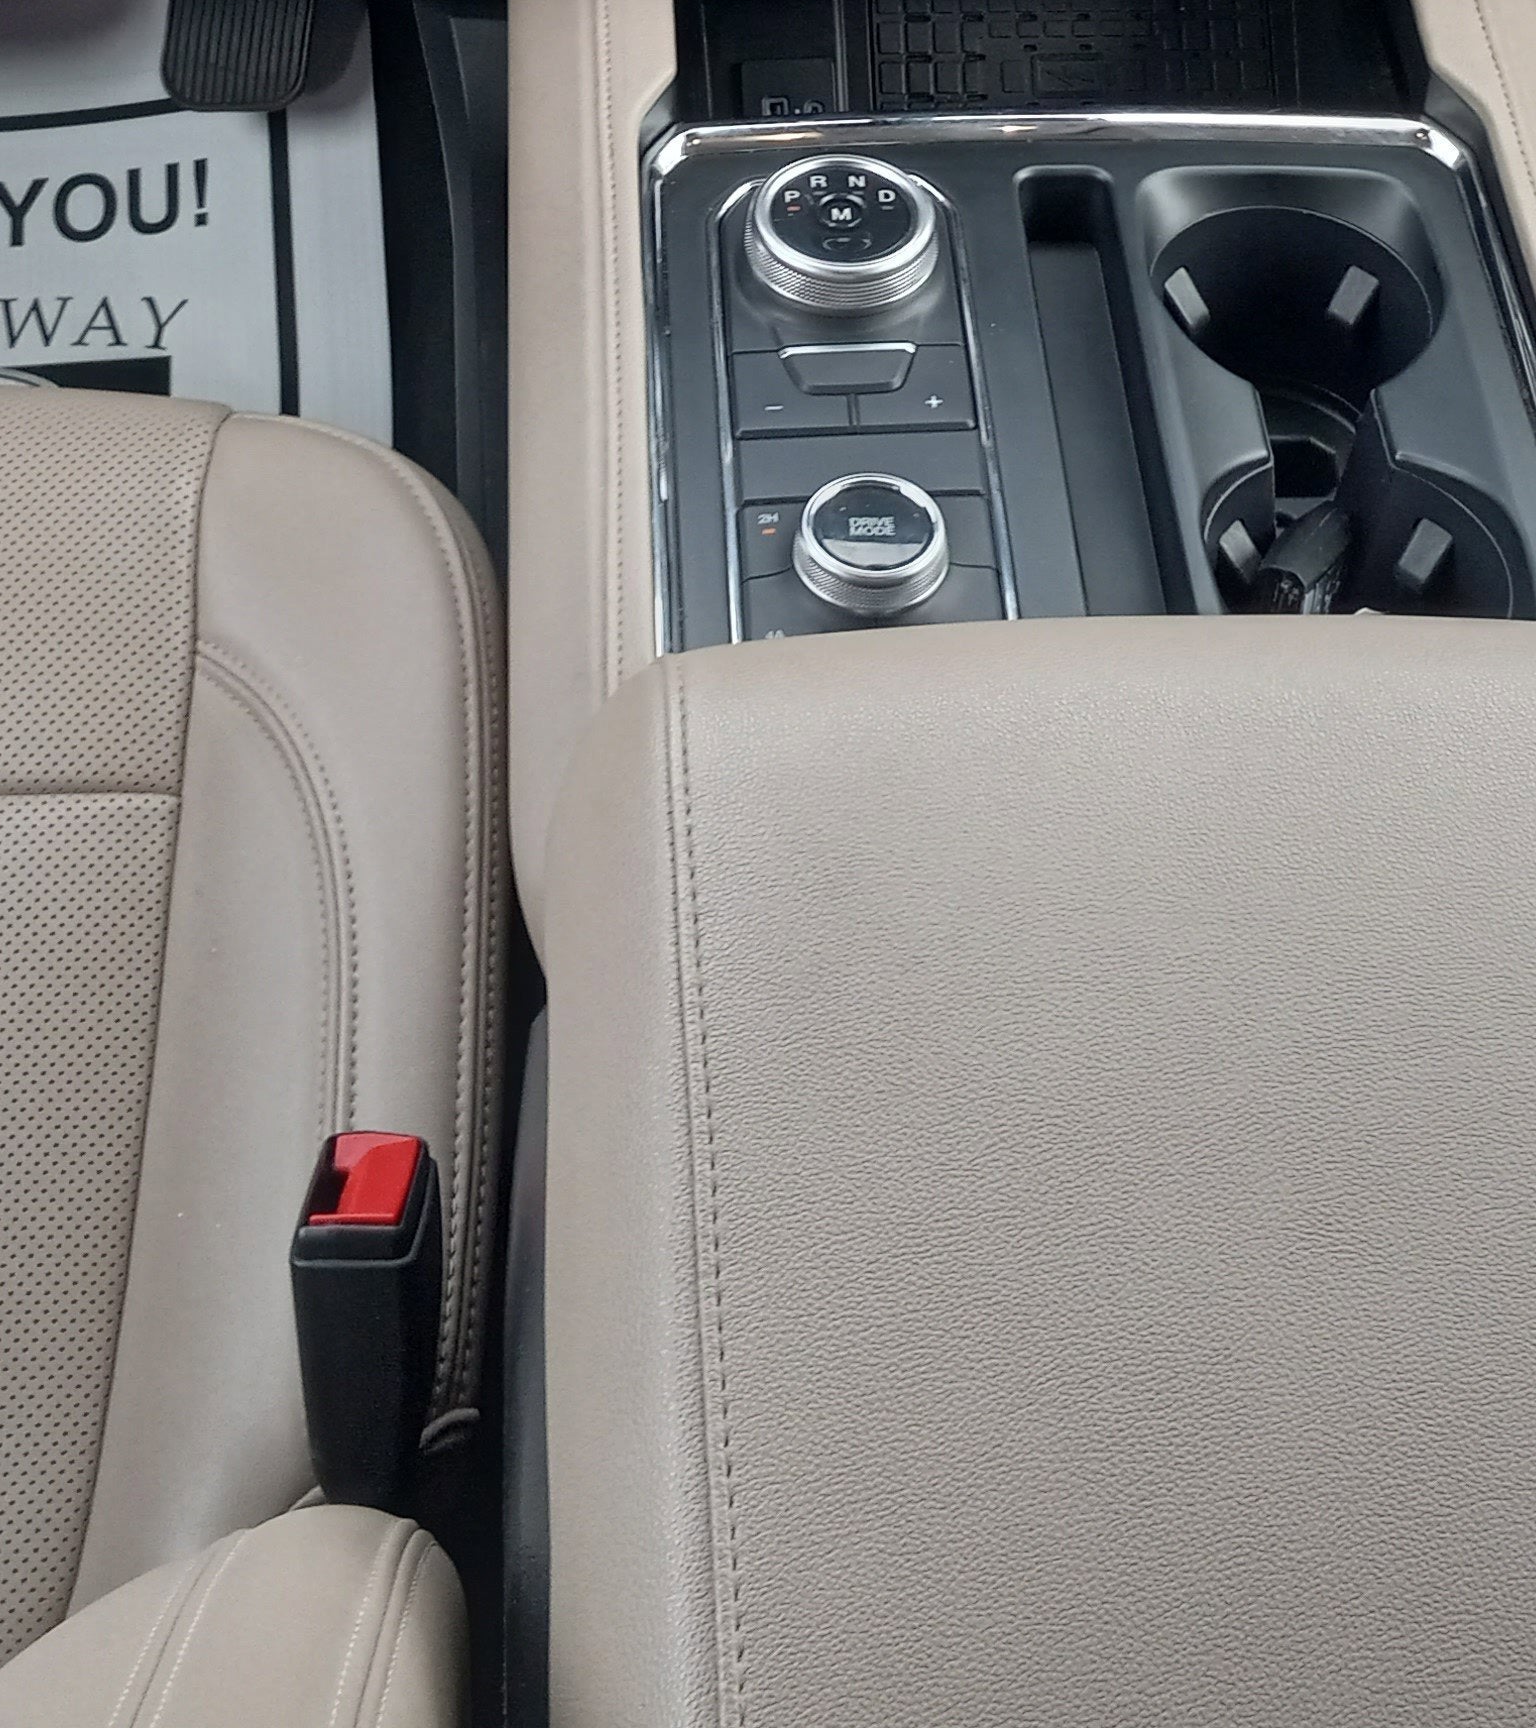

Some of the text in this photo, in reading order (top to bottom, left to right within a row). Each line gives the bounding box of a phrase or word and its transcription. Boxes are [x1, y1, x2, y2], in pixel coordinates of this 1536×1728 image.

[784, 174, 896, 204] P R N D
[831, 207, 852, 223] M
[848, 516, 895, 527] DRIVE
[849, 526, 896, 537] MODE
